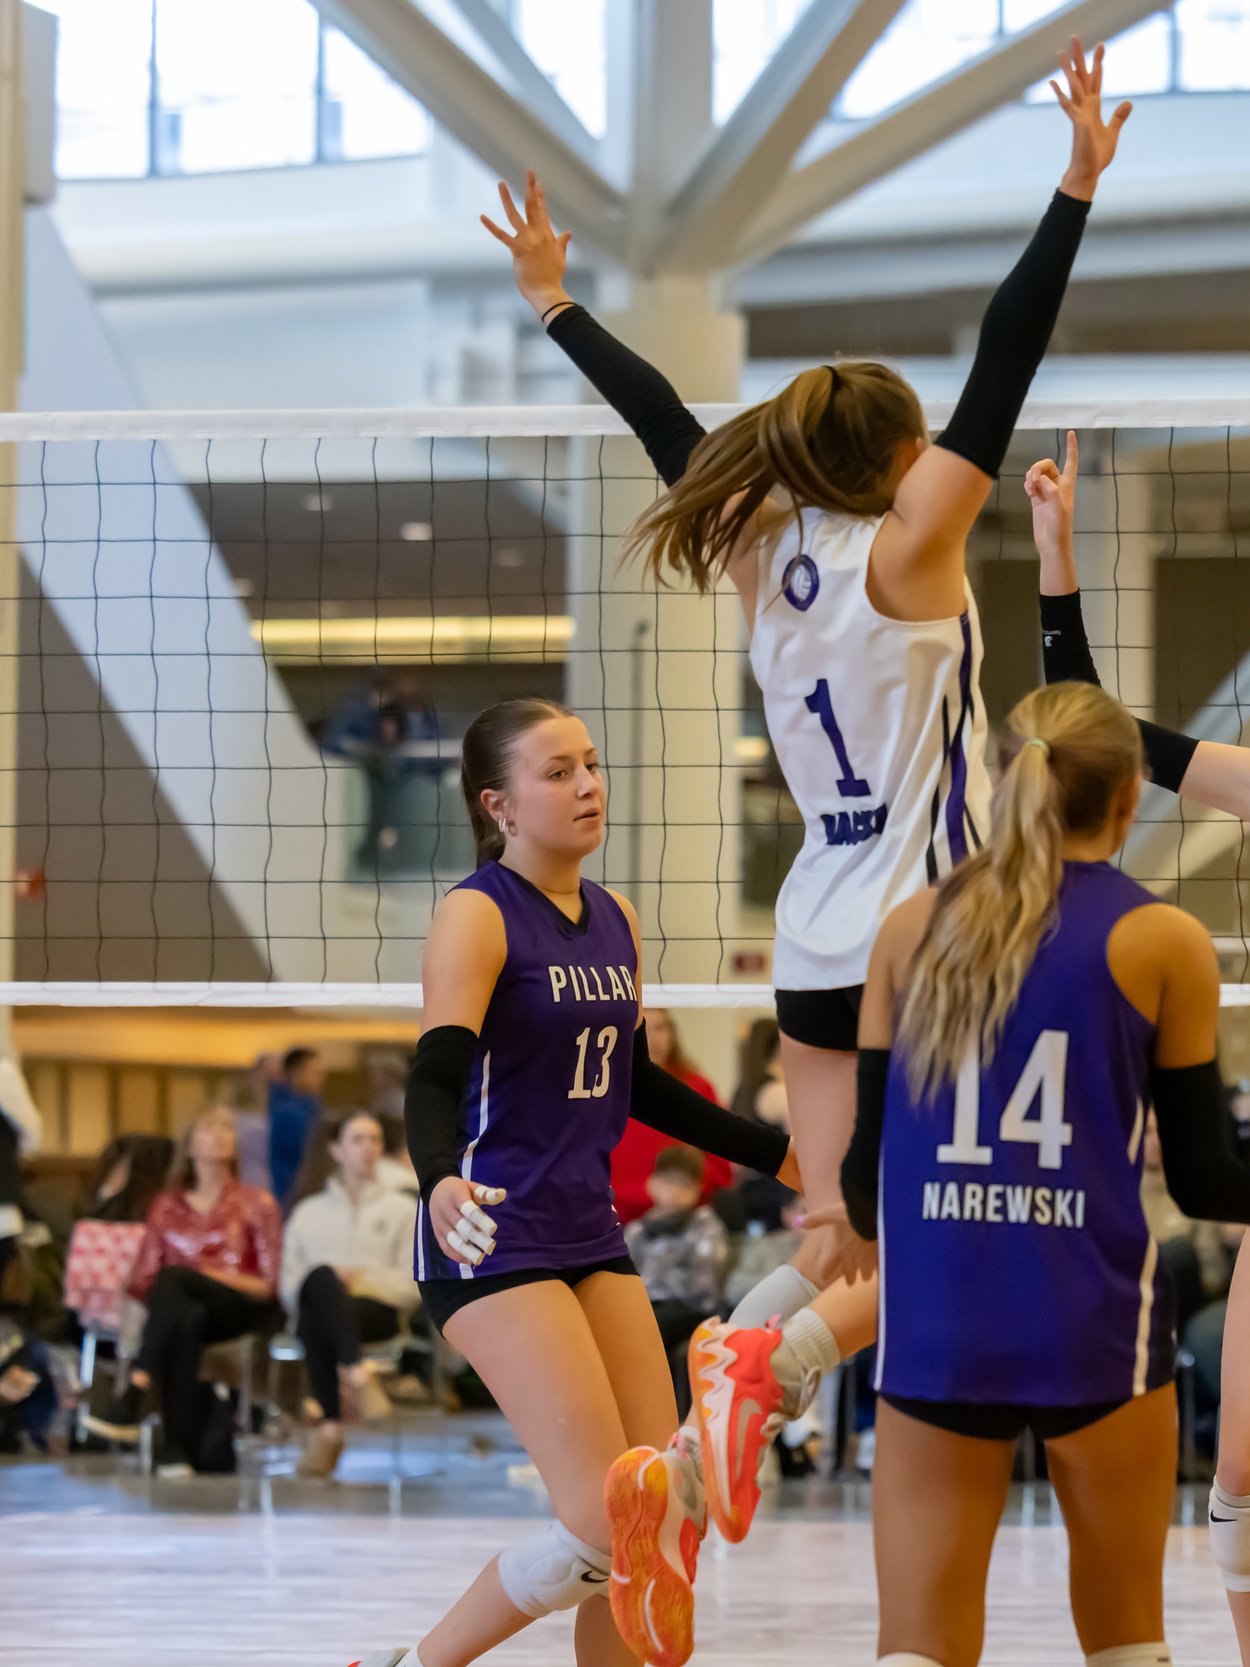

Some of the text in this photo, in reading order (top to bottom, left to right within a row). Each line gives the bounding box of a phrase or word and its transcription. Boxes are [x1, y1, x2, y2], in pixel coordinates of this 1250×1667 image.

[804, 678, 871, 797] 1
[548, 965, 638, 1003] PILLAR
[567, 1025, 618, 1099] 13
[936, 1028, 1073, 1170] 14
[922, 1181, 1085, 1228] NAREWSKI
